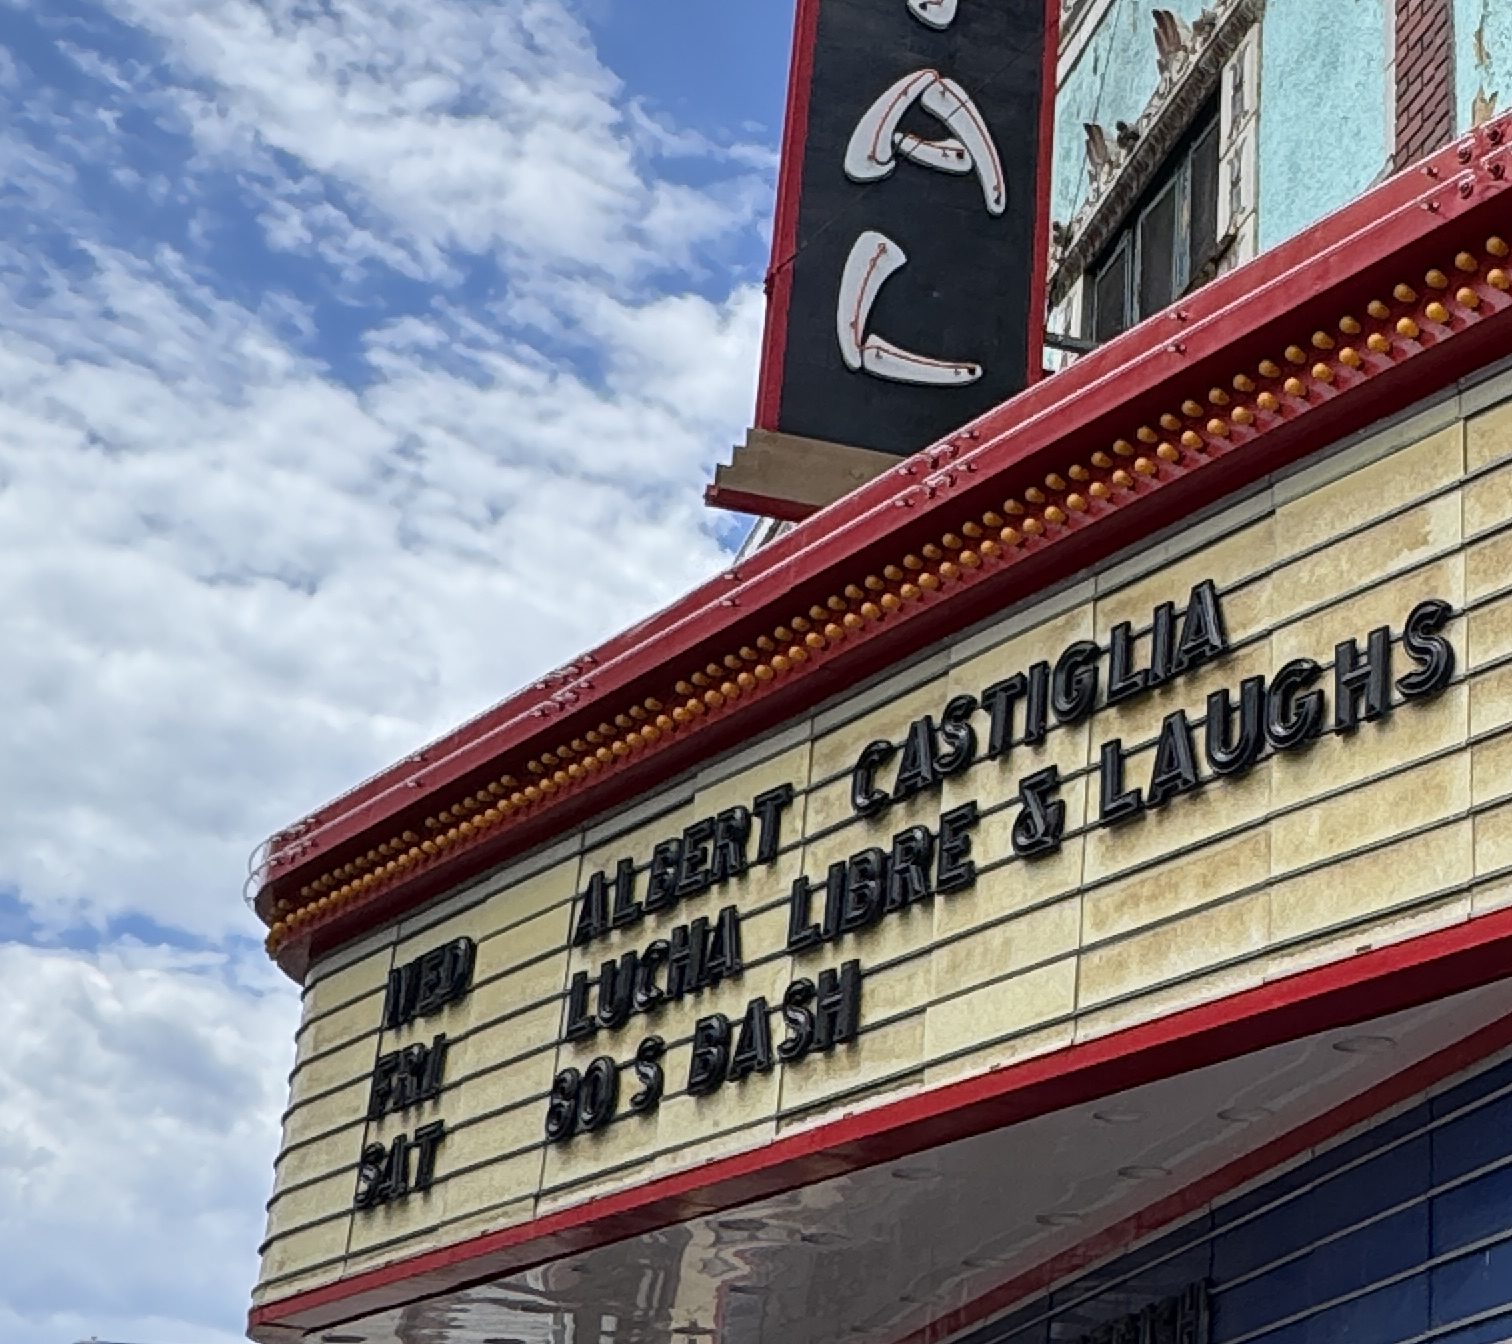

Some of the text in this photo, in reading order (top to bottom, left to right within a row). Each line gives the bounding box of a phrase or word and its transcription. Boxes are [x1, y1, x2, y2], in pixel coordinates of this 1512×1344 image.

[369, 598, 1456, 1121] FRI LUCHA LIBRE & LAUGHS
[383, 579, 1227, 1030] WED ALBERT CASTIGLIA
[354, 1120, 444, 1209] SAT
[688, 959, 861, 1097] BASH
